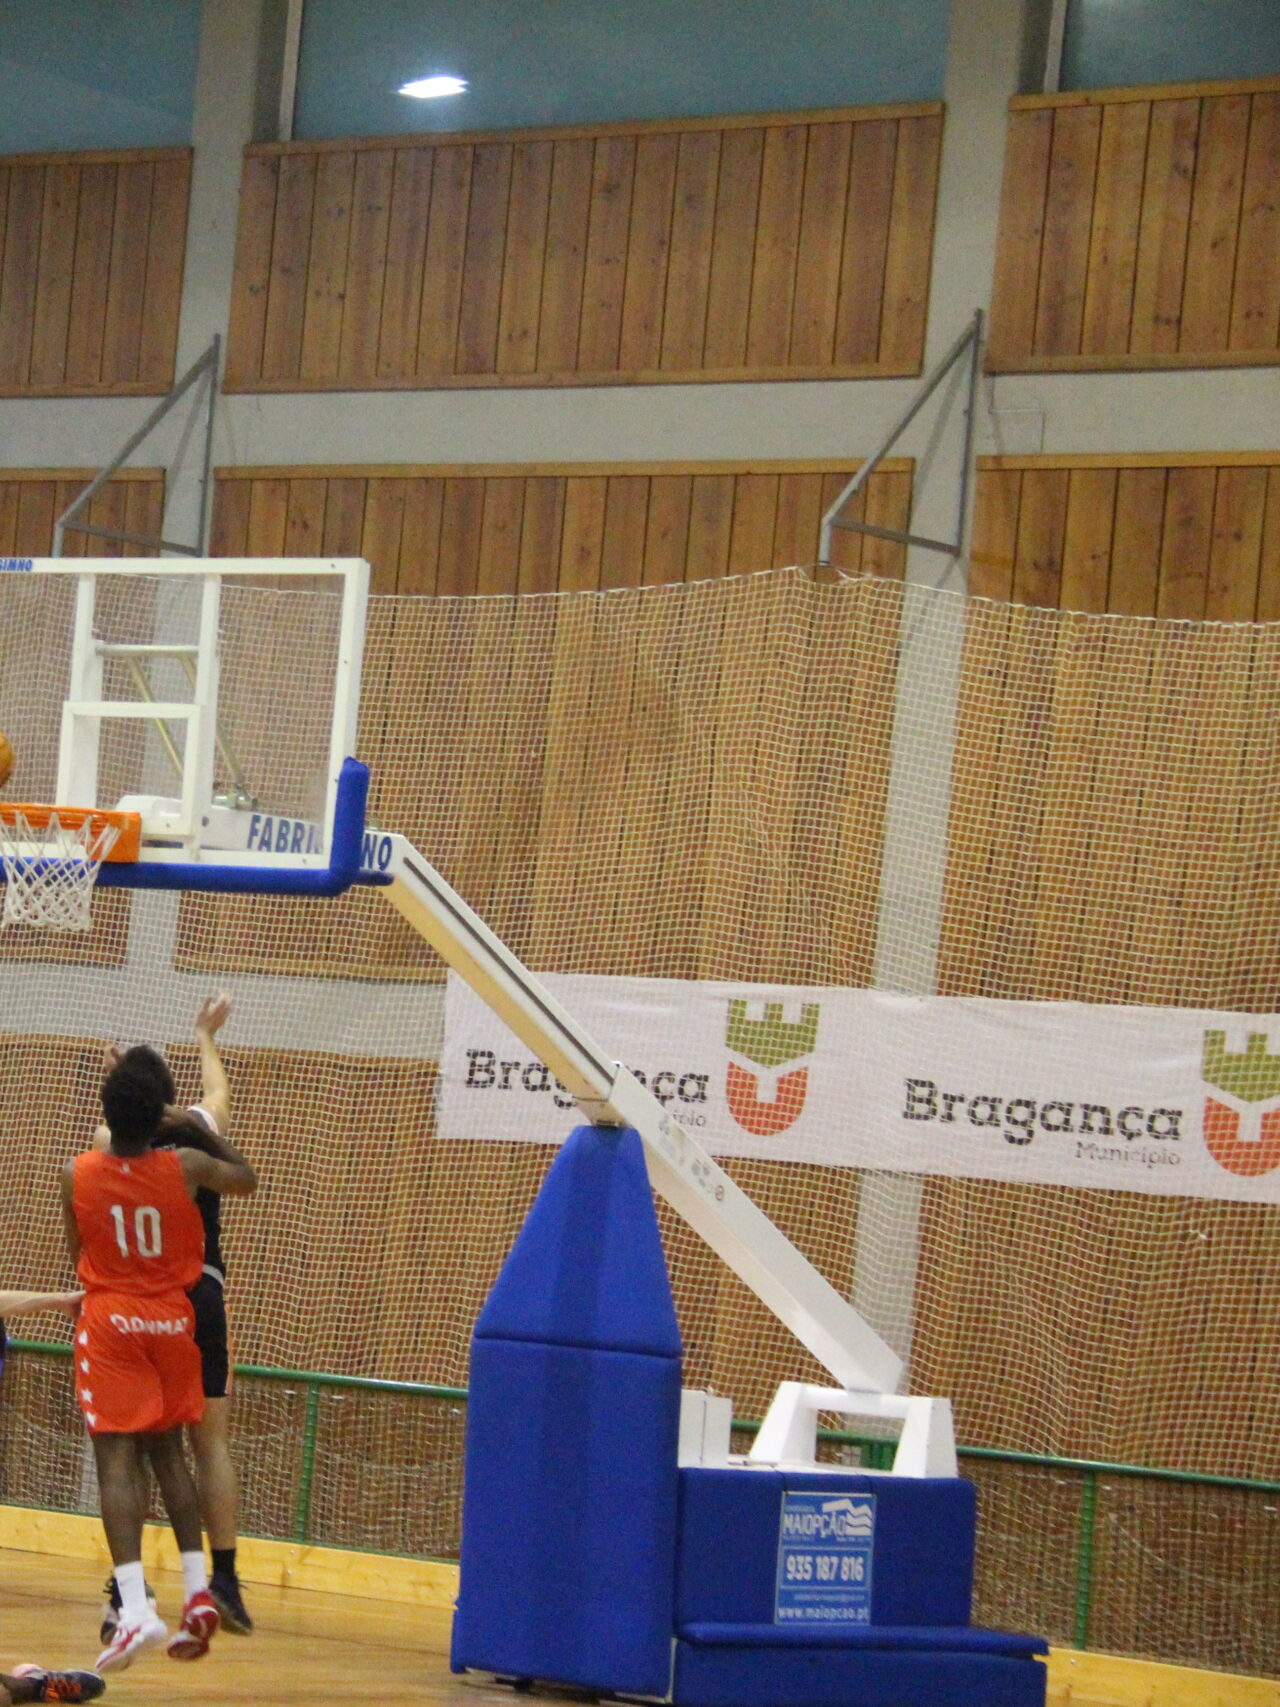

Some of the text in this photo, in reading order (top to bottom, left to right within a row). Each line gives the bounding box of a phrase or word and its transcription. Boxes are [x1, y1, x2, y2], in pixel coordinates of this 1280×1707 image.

[902, 1077, 1184, 1146] Bragança
[110, 1204, 163, 1258] 10
[782, 1511, 846, 1538] MAIOPÇÃO
[786, 1555, 864, 1581] 935 187 816
